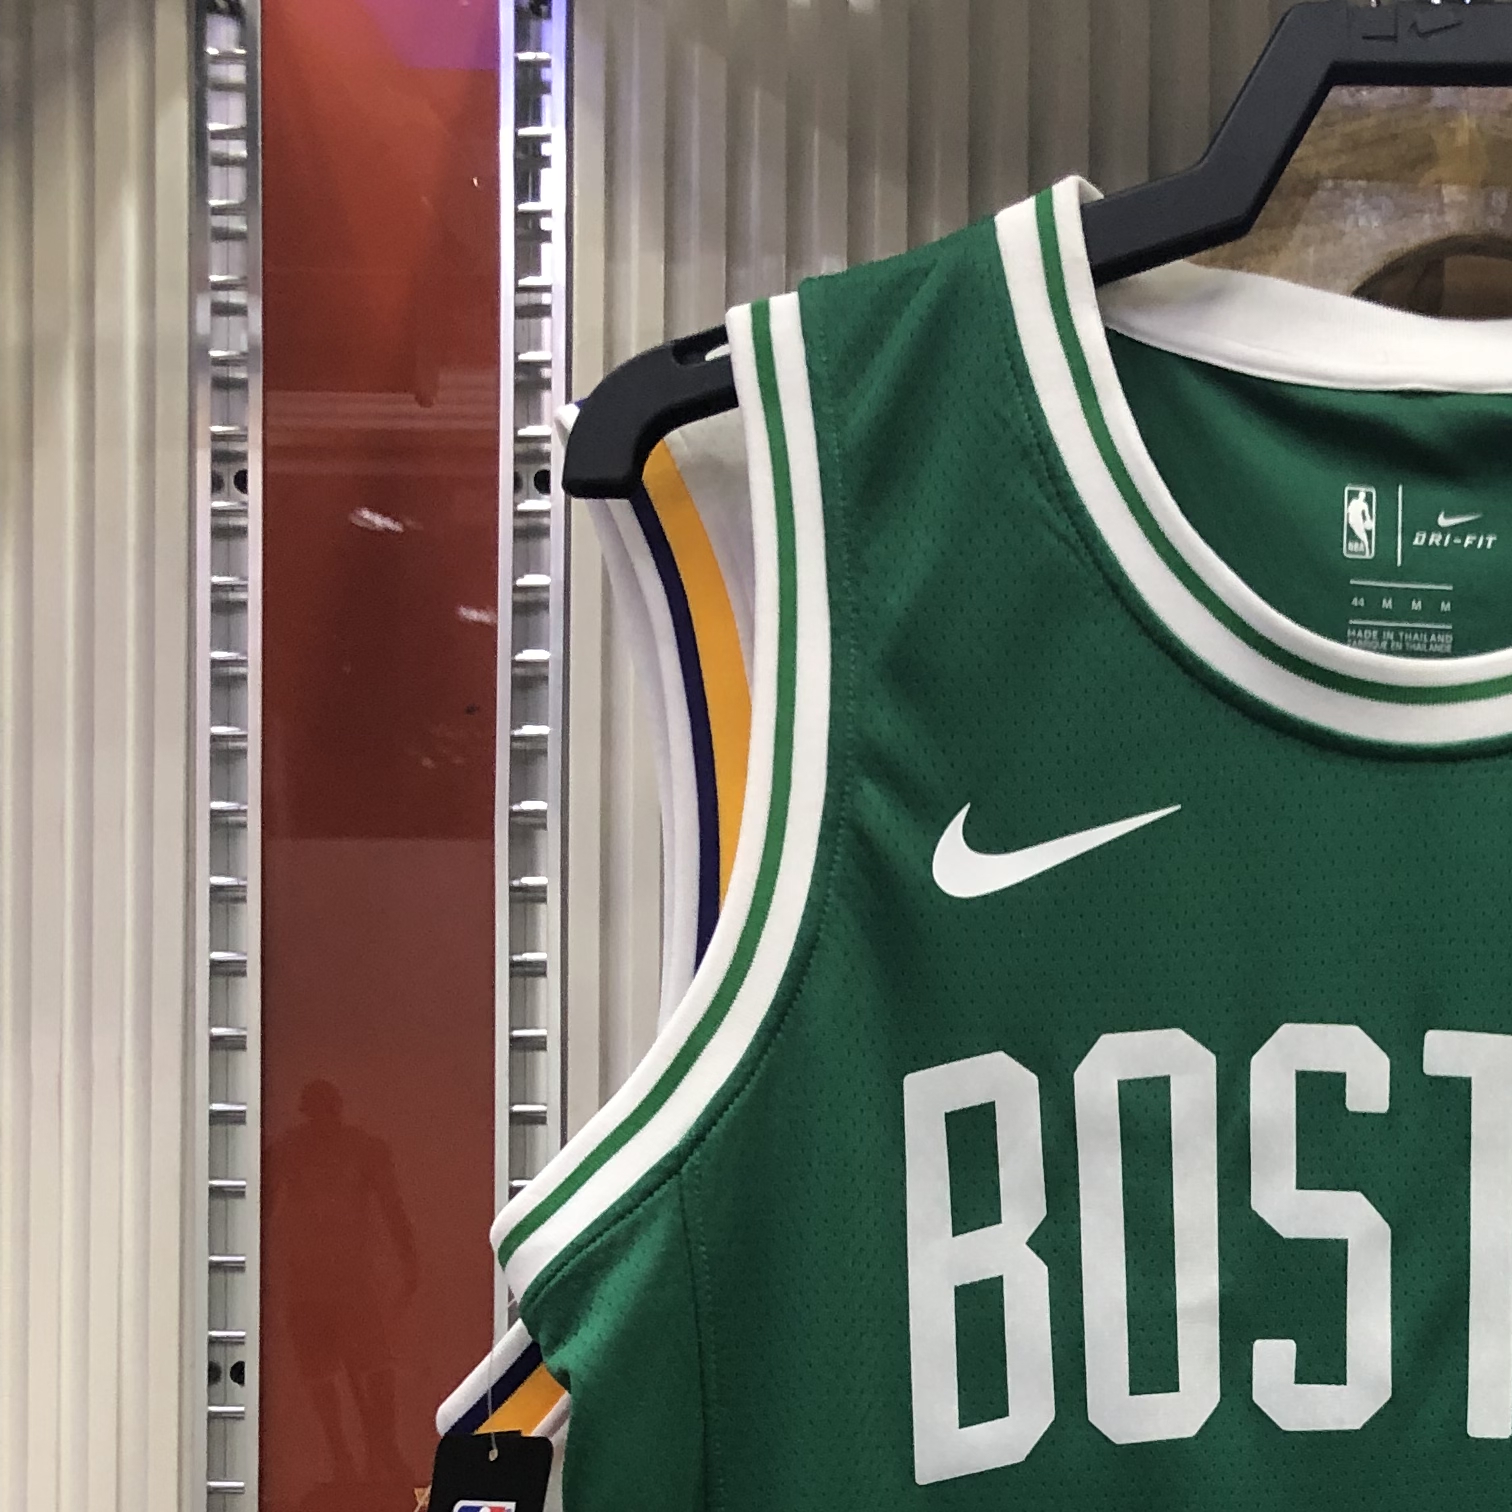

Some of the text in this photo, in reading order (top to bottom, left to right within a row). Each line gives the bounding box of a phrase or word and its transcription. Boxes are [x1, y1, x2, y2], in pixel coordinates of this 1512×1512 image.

[1413, 531, 1497, 549] DRI-FIT
[1351, 596, 1451, 612] 44 M M M
[1347, 628, 1453, 643] MADE IN THAILAND
